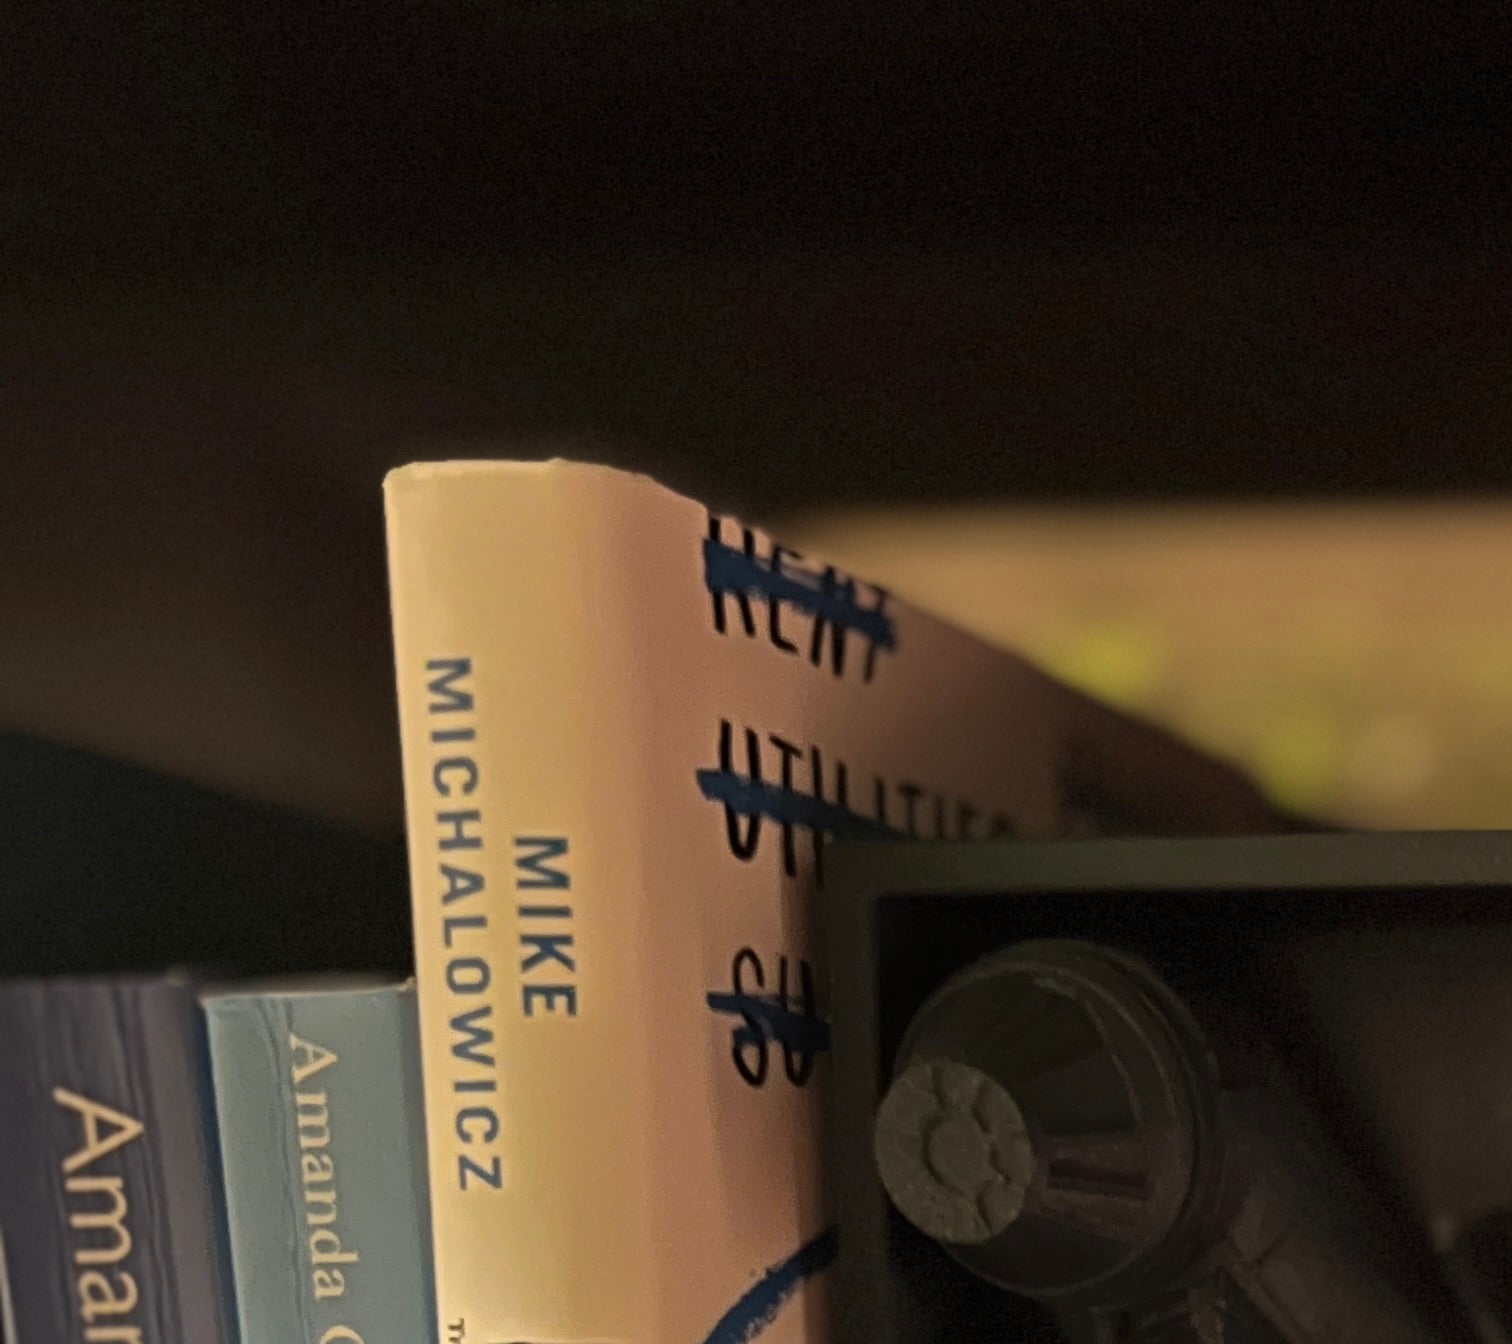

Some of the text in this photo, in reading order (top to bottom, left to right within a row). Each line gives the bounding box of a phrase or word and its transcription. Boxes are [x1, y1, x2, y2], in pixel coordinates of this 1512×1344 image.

[425, 656, 502, 1191] MICHALOWICZ
[514, 835, 577, 1018] MIKE
[289, 1031, 359, 1300] Amanda
